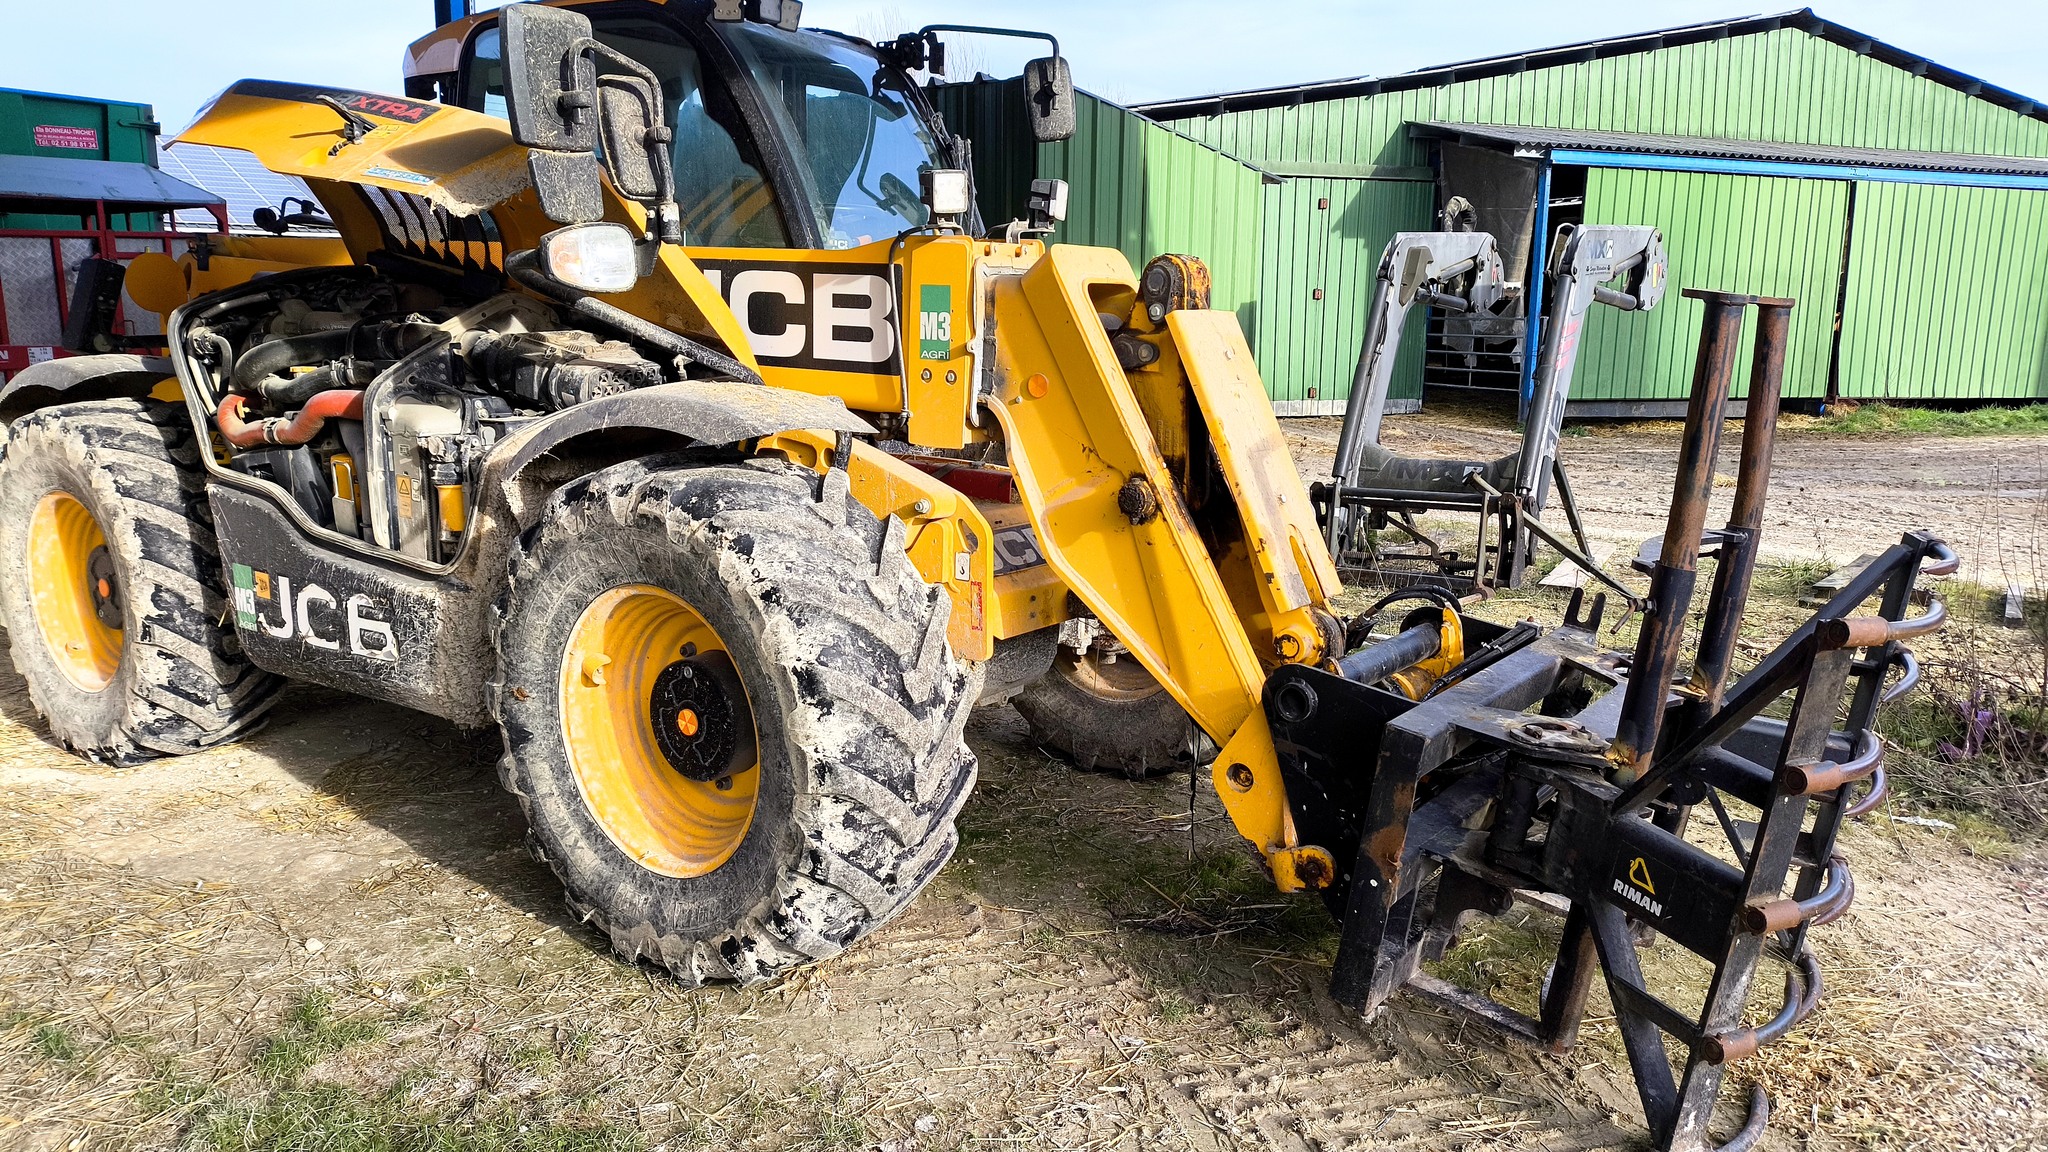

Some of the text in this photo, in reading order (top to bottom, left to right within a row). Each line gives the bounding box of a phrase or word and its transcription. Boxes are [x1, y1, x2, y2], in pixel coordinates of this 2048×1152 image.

[920, 311, 950, 341] M3
[234, 586, 256, 615] M3
[1612, 878, 1663, 917] RIMAN
